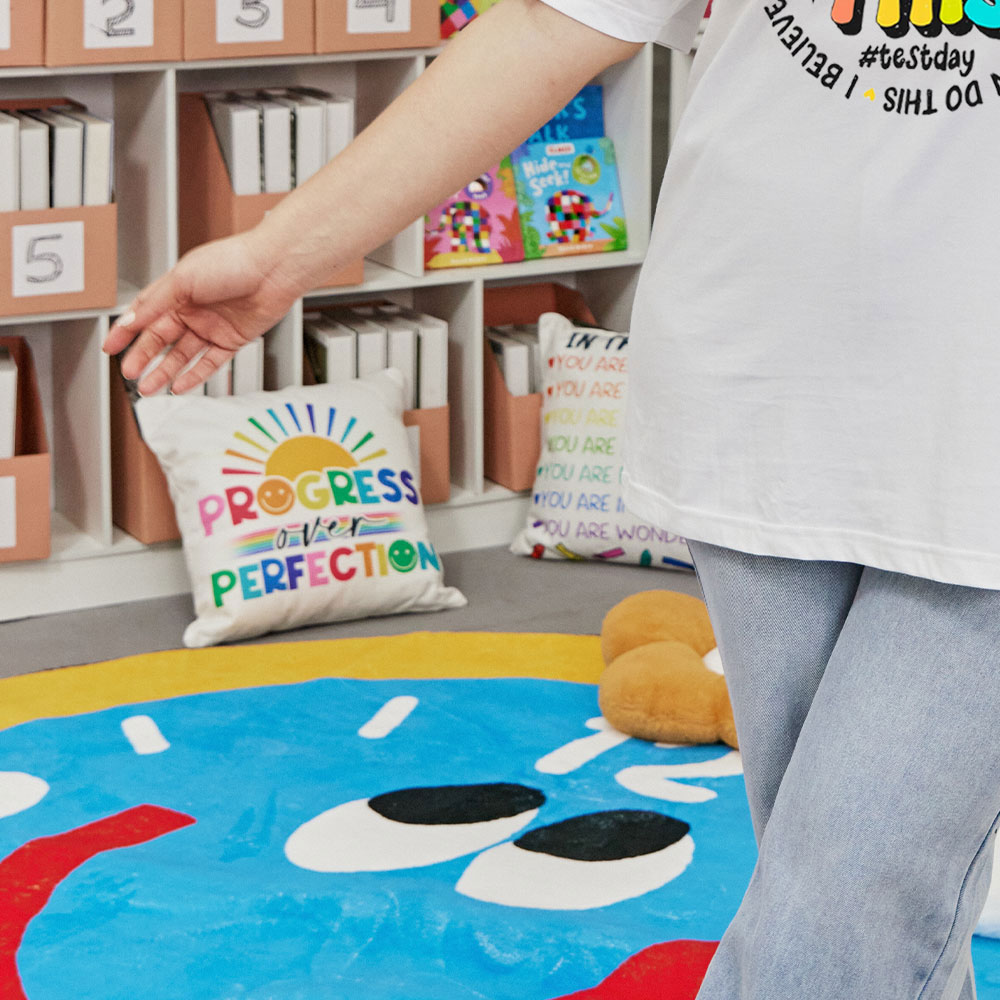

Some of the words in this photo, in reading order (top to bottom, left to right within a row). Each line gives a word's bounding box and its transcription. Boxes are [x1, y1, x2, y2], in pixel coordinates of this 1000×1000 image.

[859, 42, 975, 78] #testday
[844, 75, 859, 99] I
[947, 80, 983, 112] DO
[882, 85, 938, 116] THIS
[527, 124, 570, 142] ALK
[522, 157, 557, 178] Hide
[25, 233, 64, 284] 5
[566, 332, 598, 350] IN
[557, 355, 593, 372] YOU
[594, 355, 628, 373] ARE
[556, 380, 587, 398] YOU
[589, 381, 624, 399] ARE
[586, 408, 617, 427] ARE
[583, 436, 616, 456] ARE
[543, 464, 575, 481] YOU
[579, 465, 613, 484] ARE
[198, 468, 419, 537] PROGRESS
[541, 491, 573, 509] YOU
[576, 493, 611, 512] ARE
[276, 516, 388, 550] over
[576, 521, 609, 539] ARE
[211, 539, 441, 608] PERFECTION
